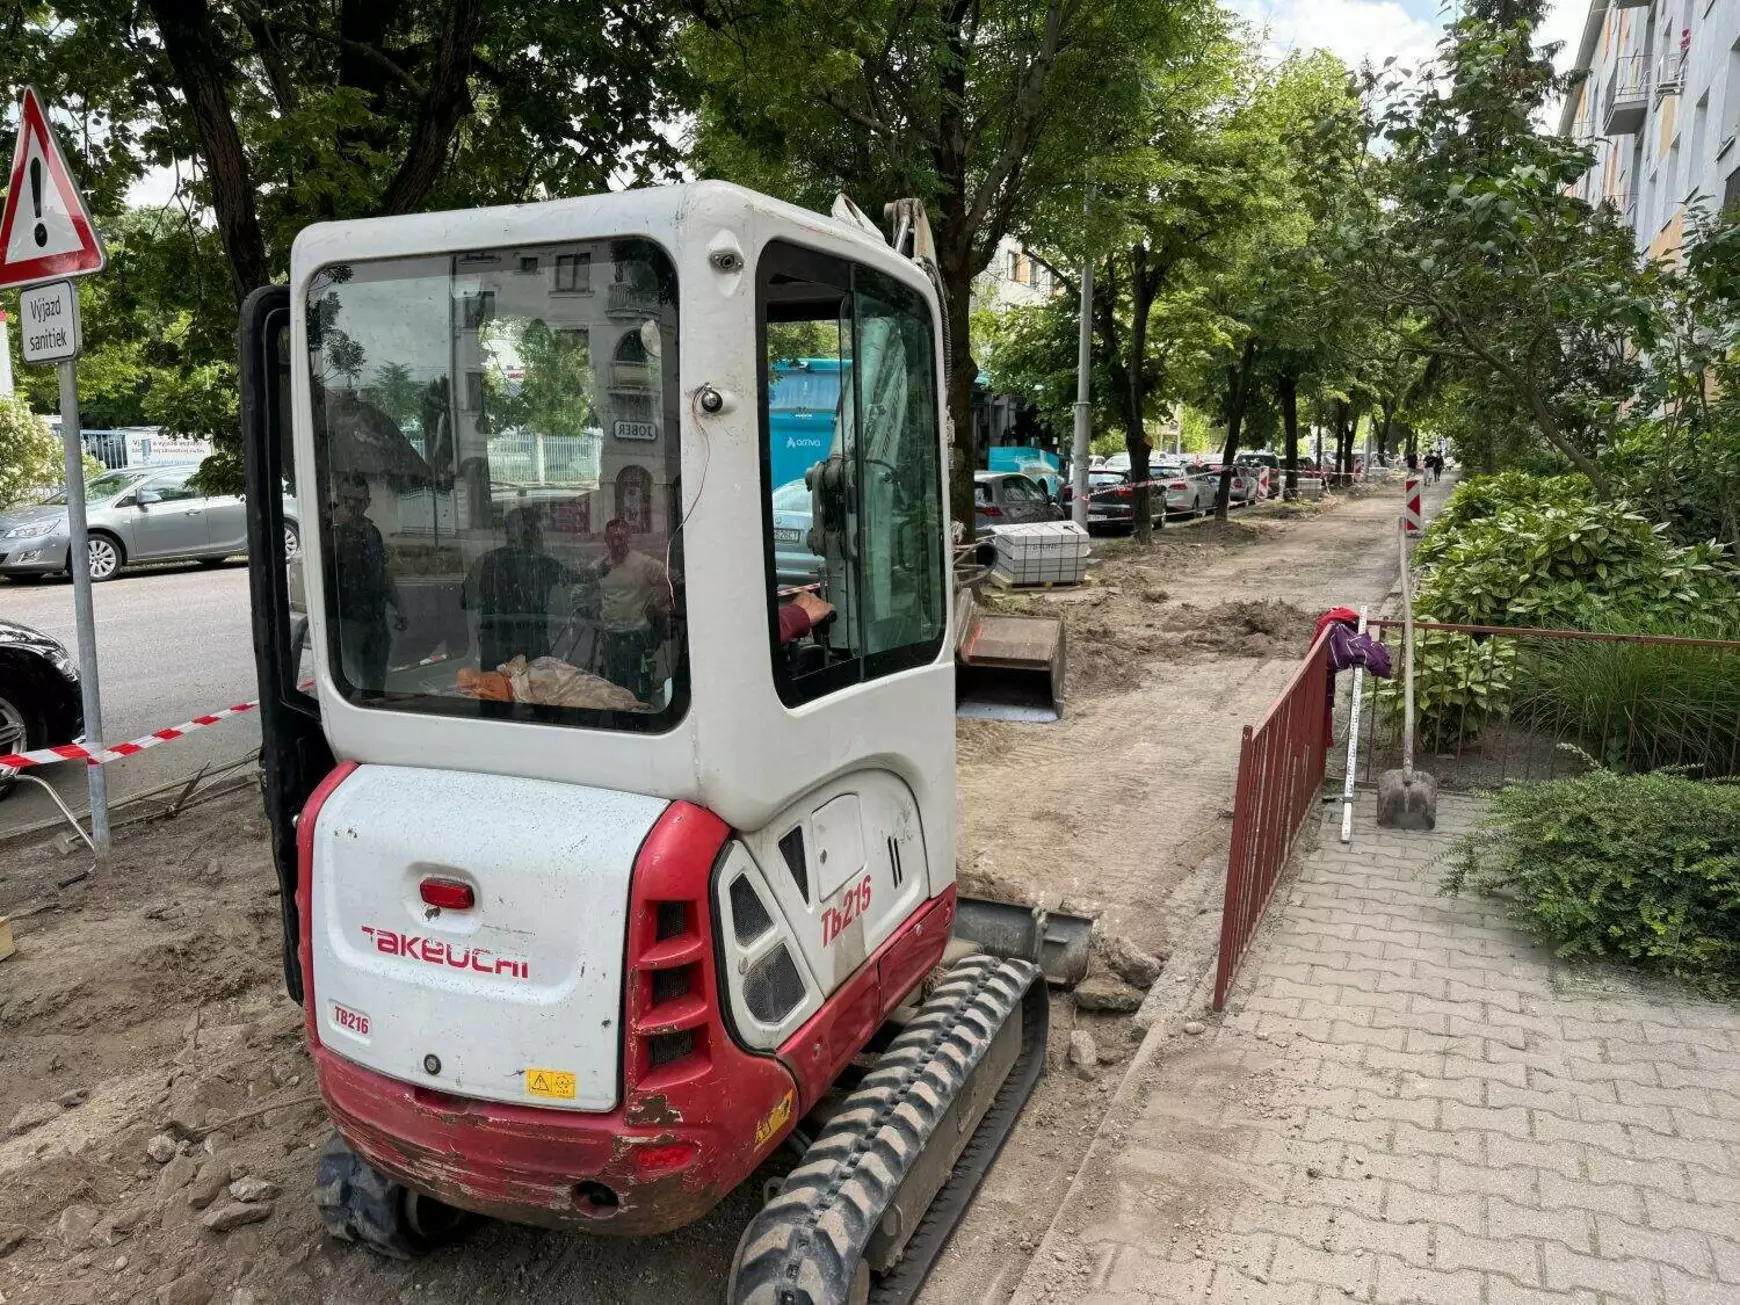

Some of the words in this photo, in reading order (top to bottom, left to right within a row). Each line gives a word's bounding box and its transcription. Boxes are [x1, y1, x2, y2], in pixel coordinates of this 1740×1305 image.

[30, 295, 61, 323] Výjazd
[29, 327, 67, 352] sanitiek
[335, 1006, 369, 1034] TB216
